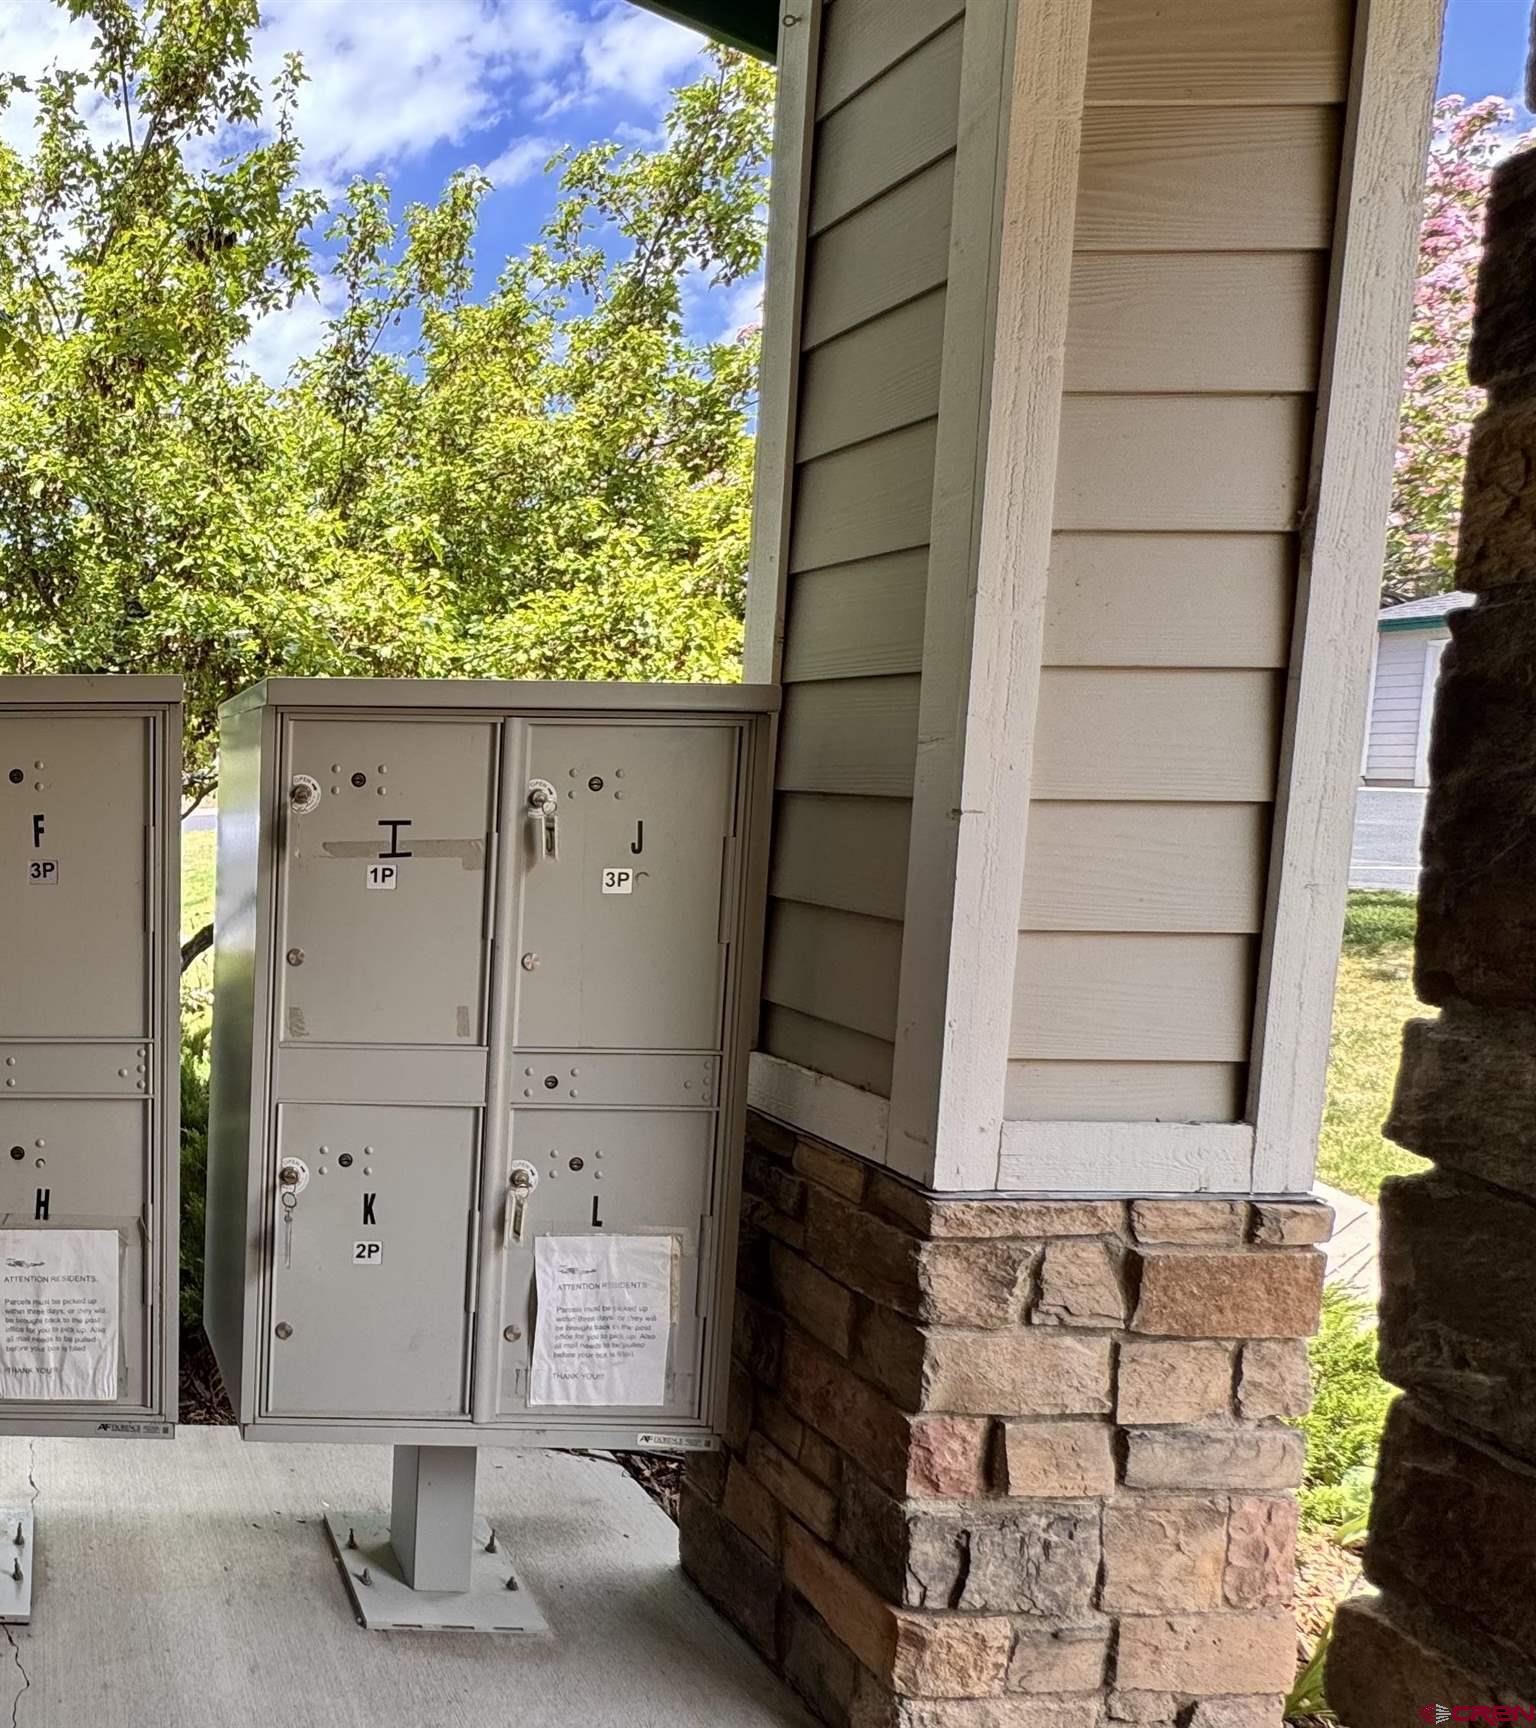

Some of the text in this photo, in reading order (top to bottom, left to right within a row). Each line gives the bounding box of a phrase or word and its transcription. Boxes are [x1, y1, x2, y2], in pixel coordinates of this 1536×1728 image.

[33, 814, 45, 848] F
[378, 819, 413, 859] I
[630, 820, 644, 855] J
[30, 862, 55, 879] 3P
[370, 867, 394, 884] 1P
[605, 871, 630, 888] 3P
[34, 1188, 50, 1221] H
[363, 1193, 377, 1225] K
[591, 1195, 603, 1228] L
[355, 1243, 380, 1259] 2P
